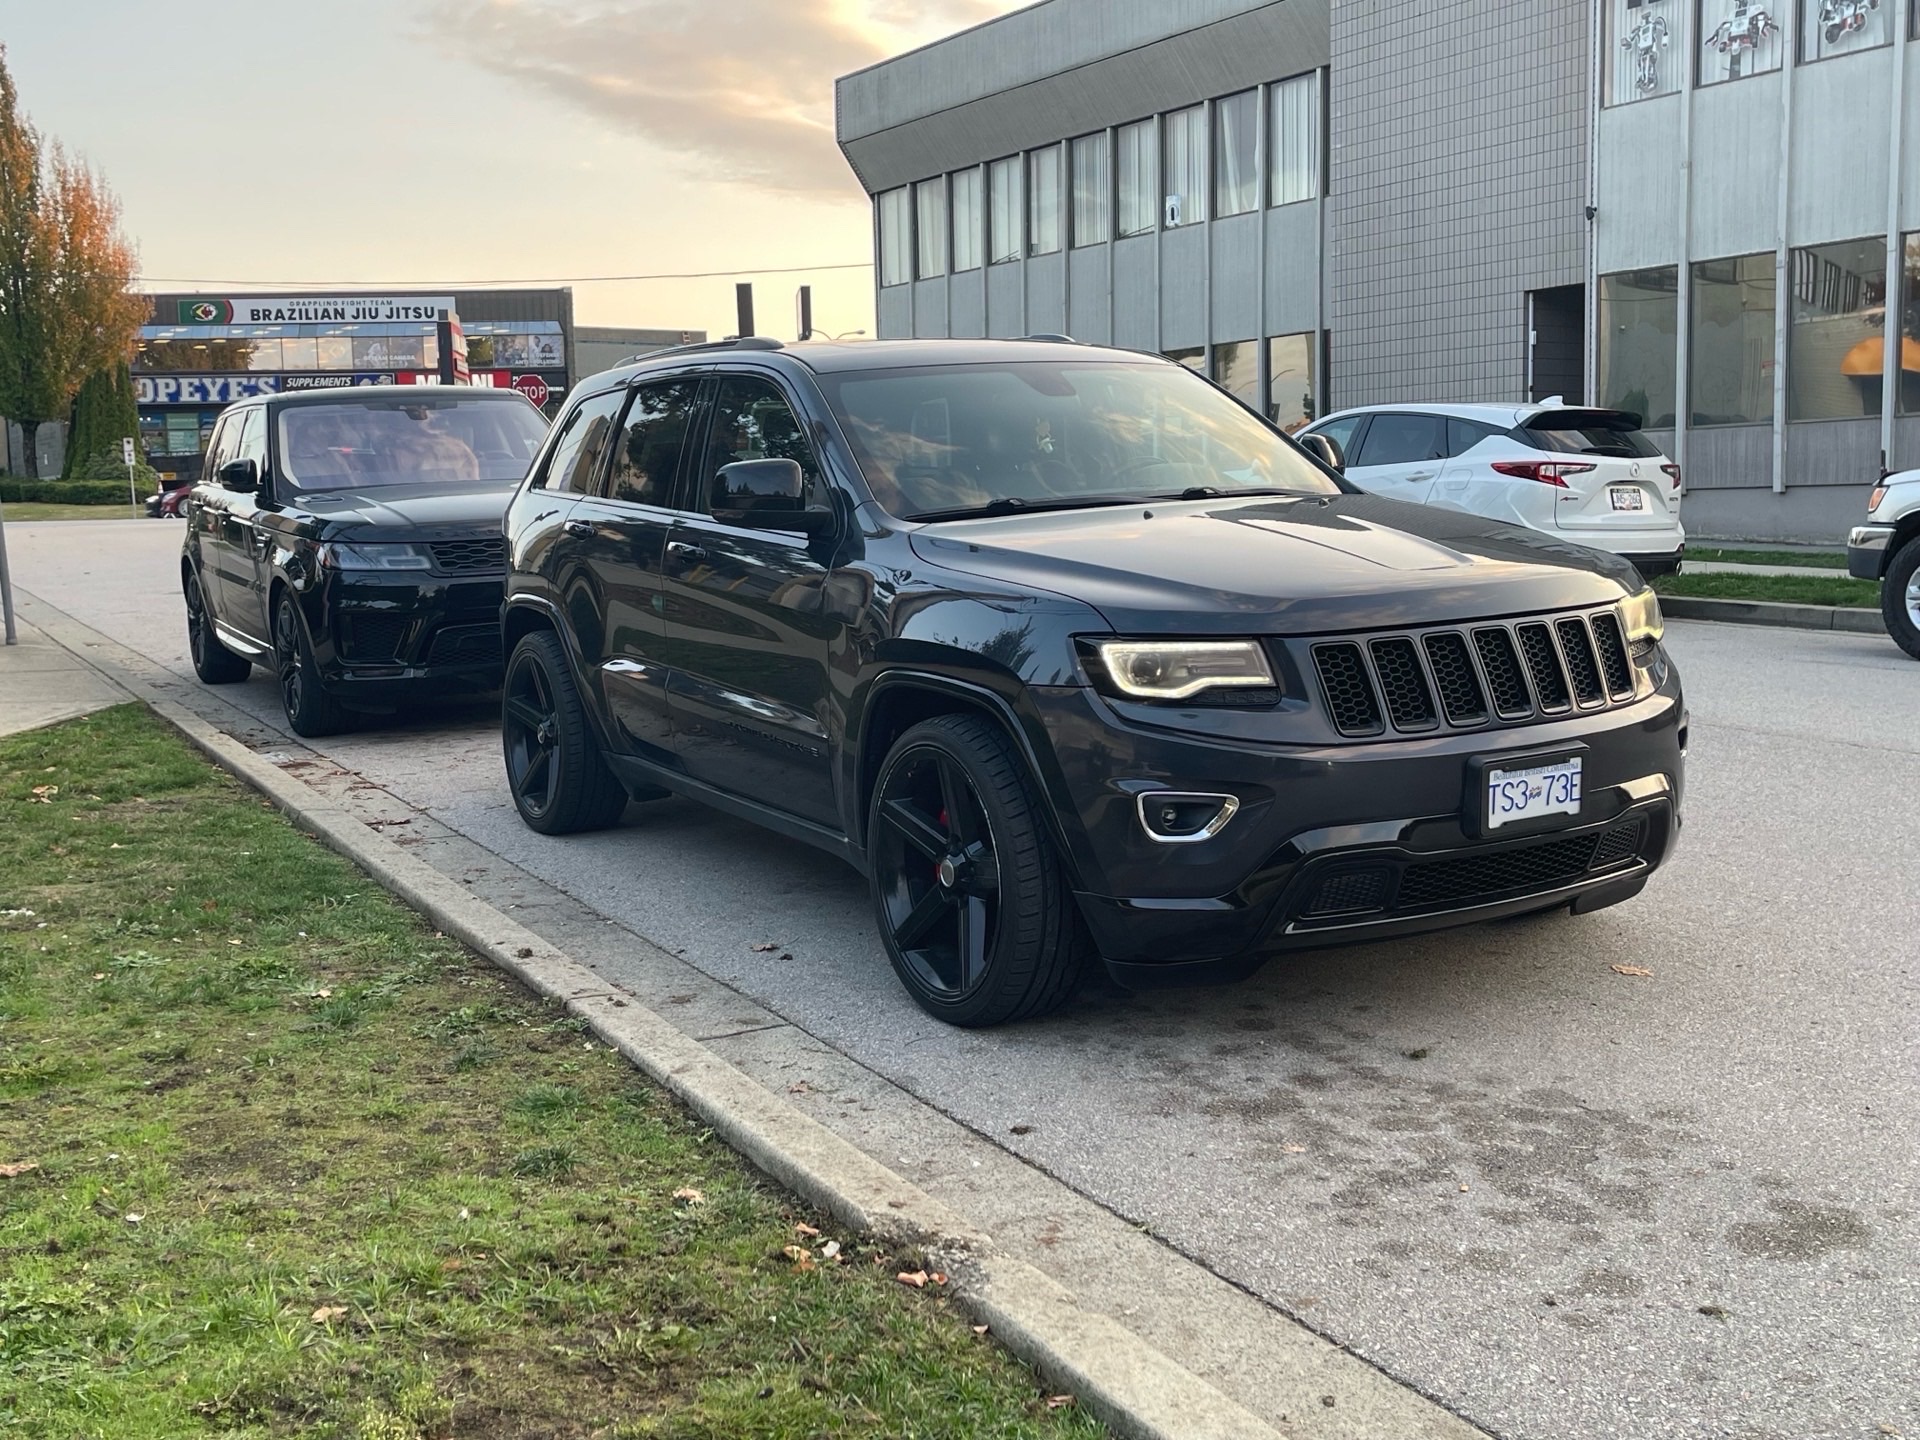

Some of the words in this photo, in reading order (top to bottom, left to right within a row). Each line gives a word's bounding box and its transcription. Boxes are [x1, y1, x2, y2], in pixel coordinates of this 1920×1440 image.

[250, 308, 346, 321] BRAZILIAN
[351, 307, 379, 320] JIU
[385, 306, 436, 319] JITSU
[137, 377, 276, 403] OPEYE'S
[286, 377, 351, 388] SUPPLEMENTS
[1493, 771, 1523, 781] Beautiful
[1524, 768, 1546, 777] British
[1546, 762, 1579, 772] Columbia
[1488, 779, 1529, 815] TS3
[1542, 771, 1582, 806] 73E
